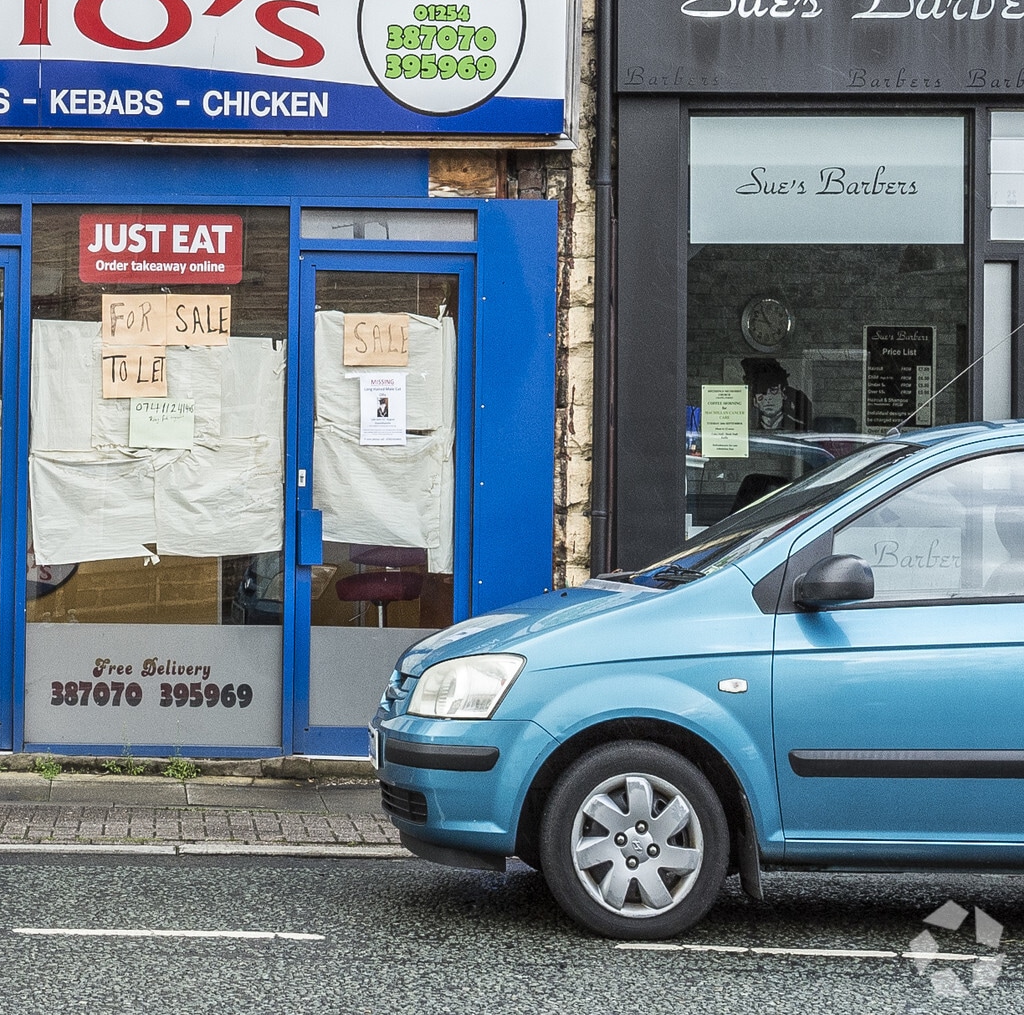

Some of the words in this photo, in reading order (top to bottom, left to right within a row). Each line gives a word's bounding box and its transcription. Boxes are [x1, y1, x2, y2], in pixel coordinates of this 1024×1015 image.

[413, 4, 470, 22] 01254
[386, 24, 496, 51] 387070
[385, 53, 496, 80] 395969
[624, 65, 720, 85] Barbers
[846, 67, 941, 88] Barbers
[49, 88, 163, 116] KEBABS
[202, 90, 329, 118] CHICKEN
[735, 167, 806, 195] Sue's
[815, 166, 919, 195] Barbers
[88, 223, 166, 253] JUST
[173, 224, 233, 254] EAT
[95, 260, 128, 271] Order
[131, 260, 187, 274] takeaway
[189, 261, 225, 272] online
[110, 302, 151, 336] FOR
[175, 304, 229, 334] SALE
[354, 322, 408, 353] SALE
[871, 330, 894, 340] Sue's
[896, 330, 928, 341] Barbers
[103, 355, 127, 383] TO
[137, 356, 166, 383] LET
[93, 658, 133, 677] Free
[141, 657, 211, 680] Delivery
[50, 681, 142, 707] 387070
[160, 682, 253, 708] 395969
